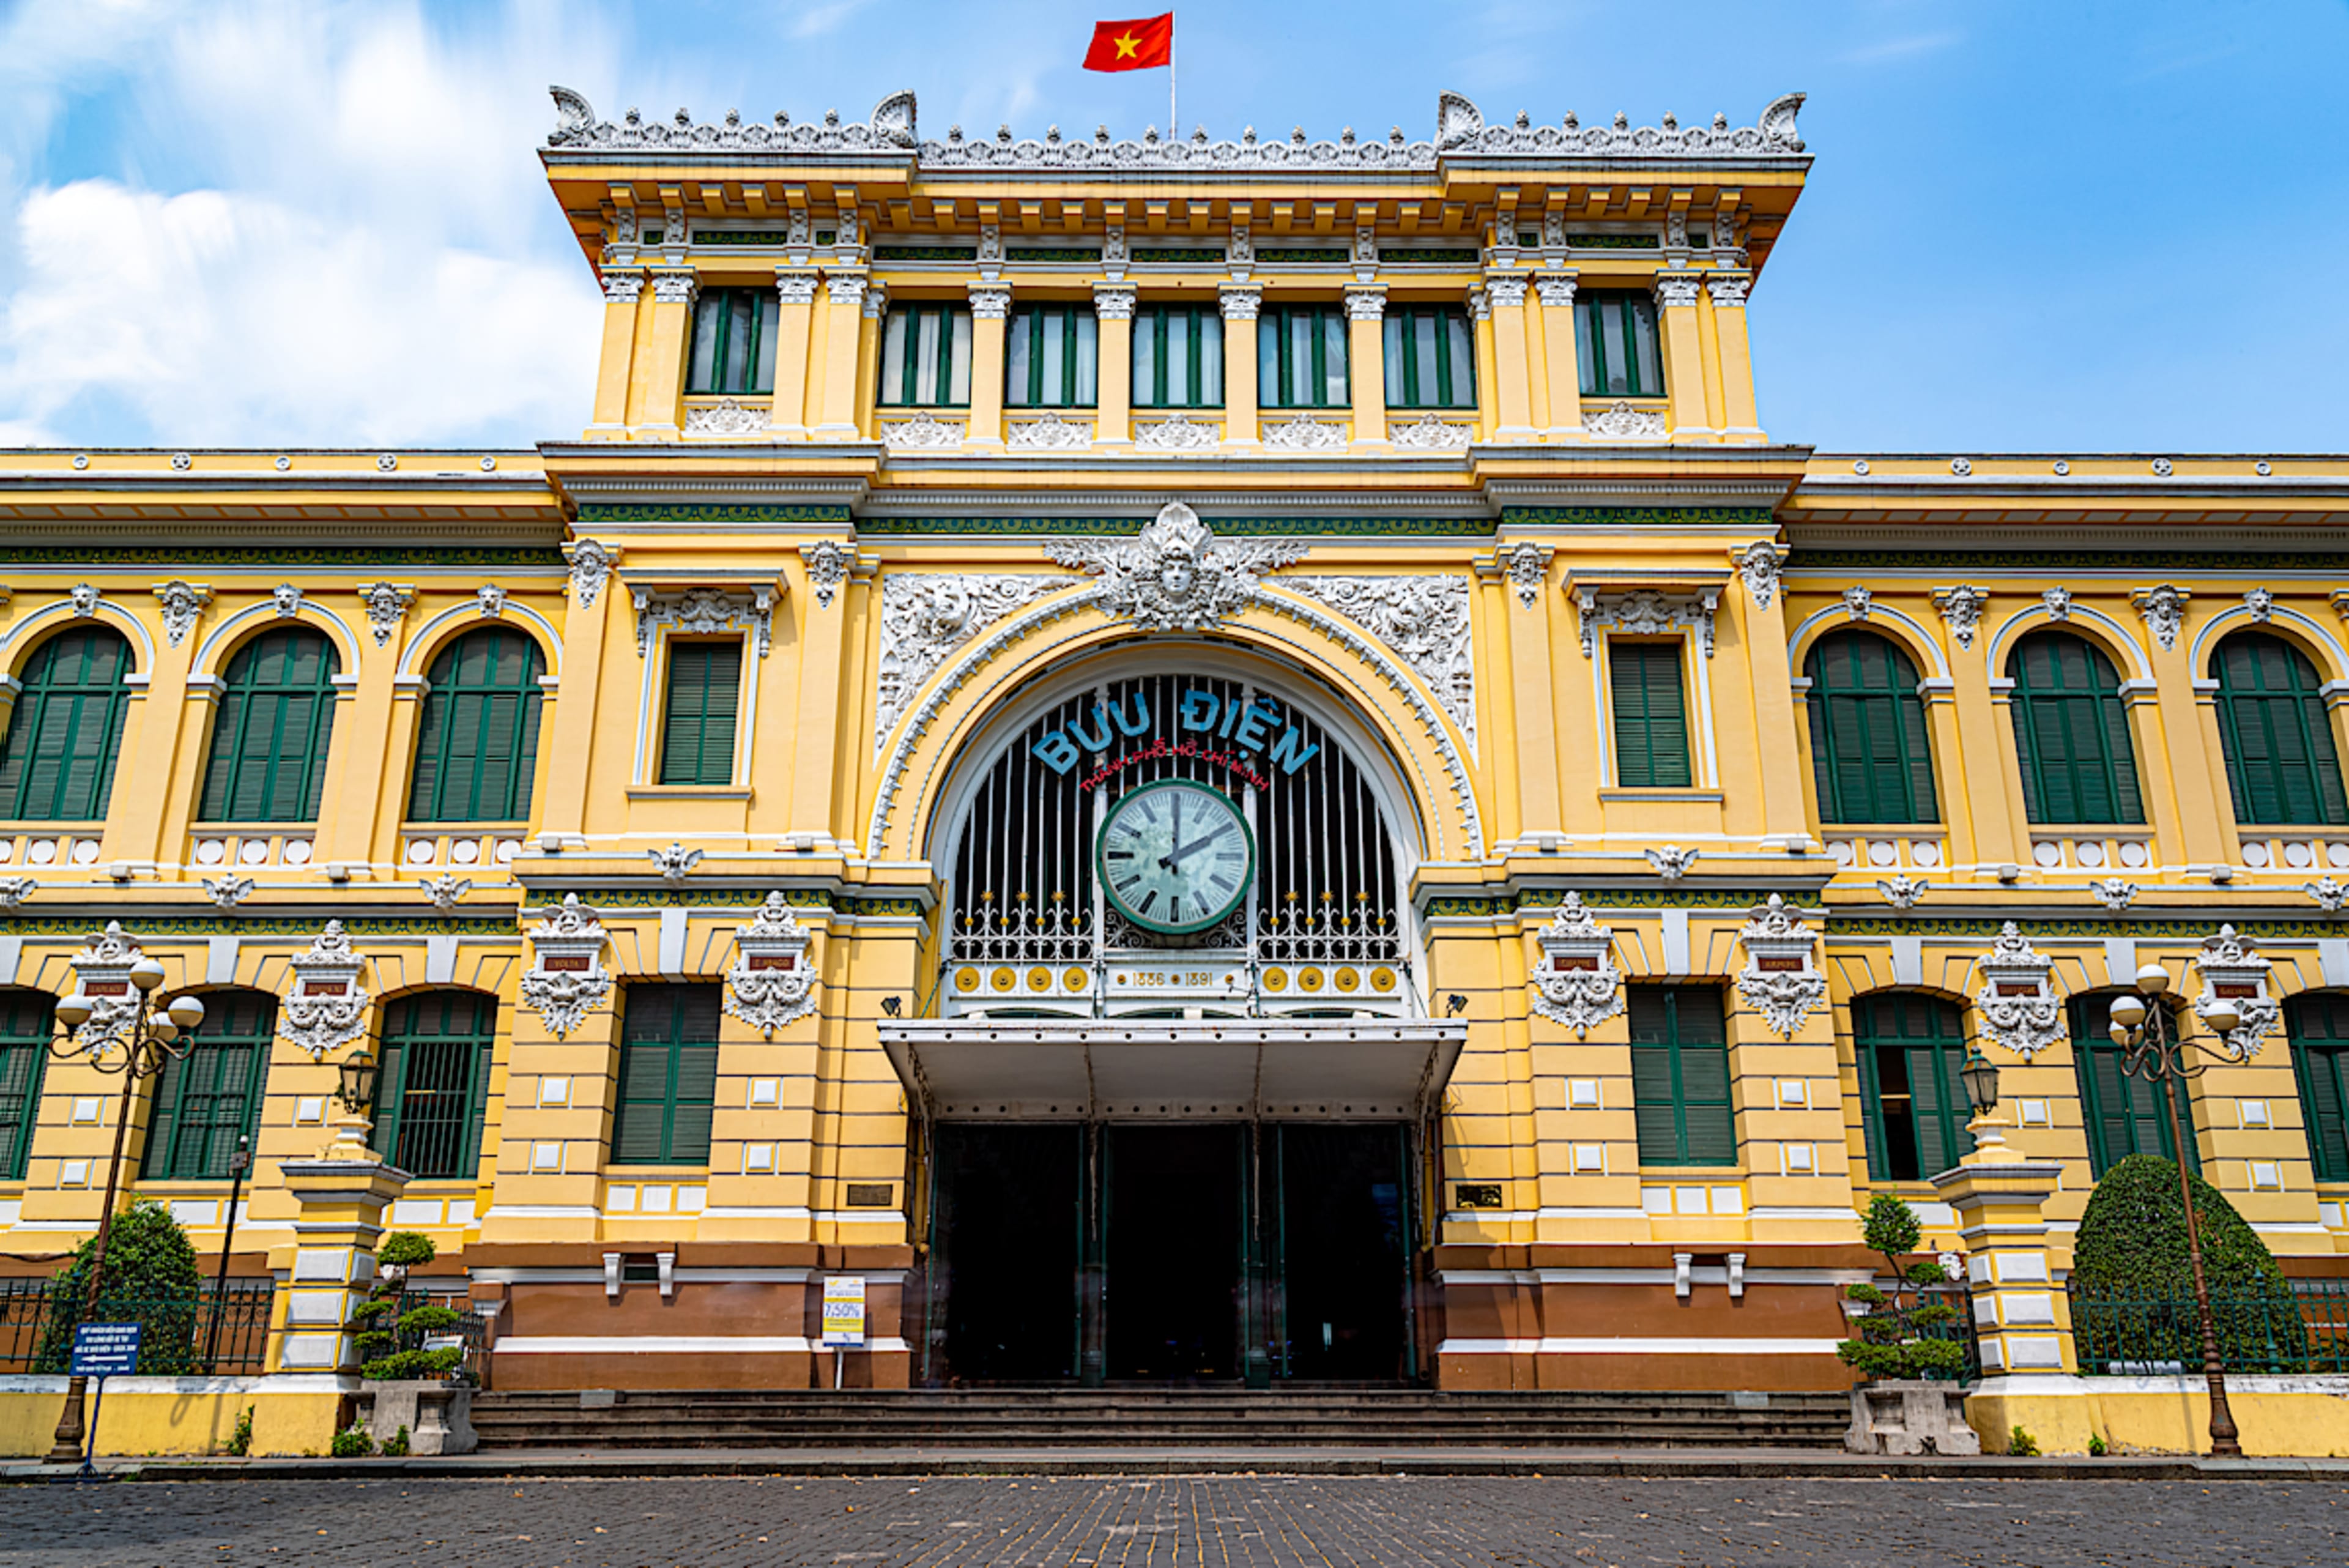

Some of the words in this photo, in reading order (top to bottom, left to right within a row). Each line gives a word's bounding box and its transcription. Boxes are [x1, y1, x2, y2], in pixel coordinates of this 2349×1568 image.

[1031, 692, 1151, 776] BƯU
[1180, 688, 1319, 776] ĐIỆN
[1172, 737, 1198, 757] HỒ
[1230, 759, 1270, 791] MINH
